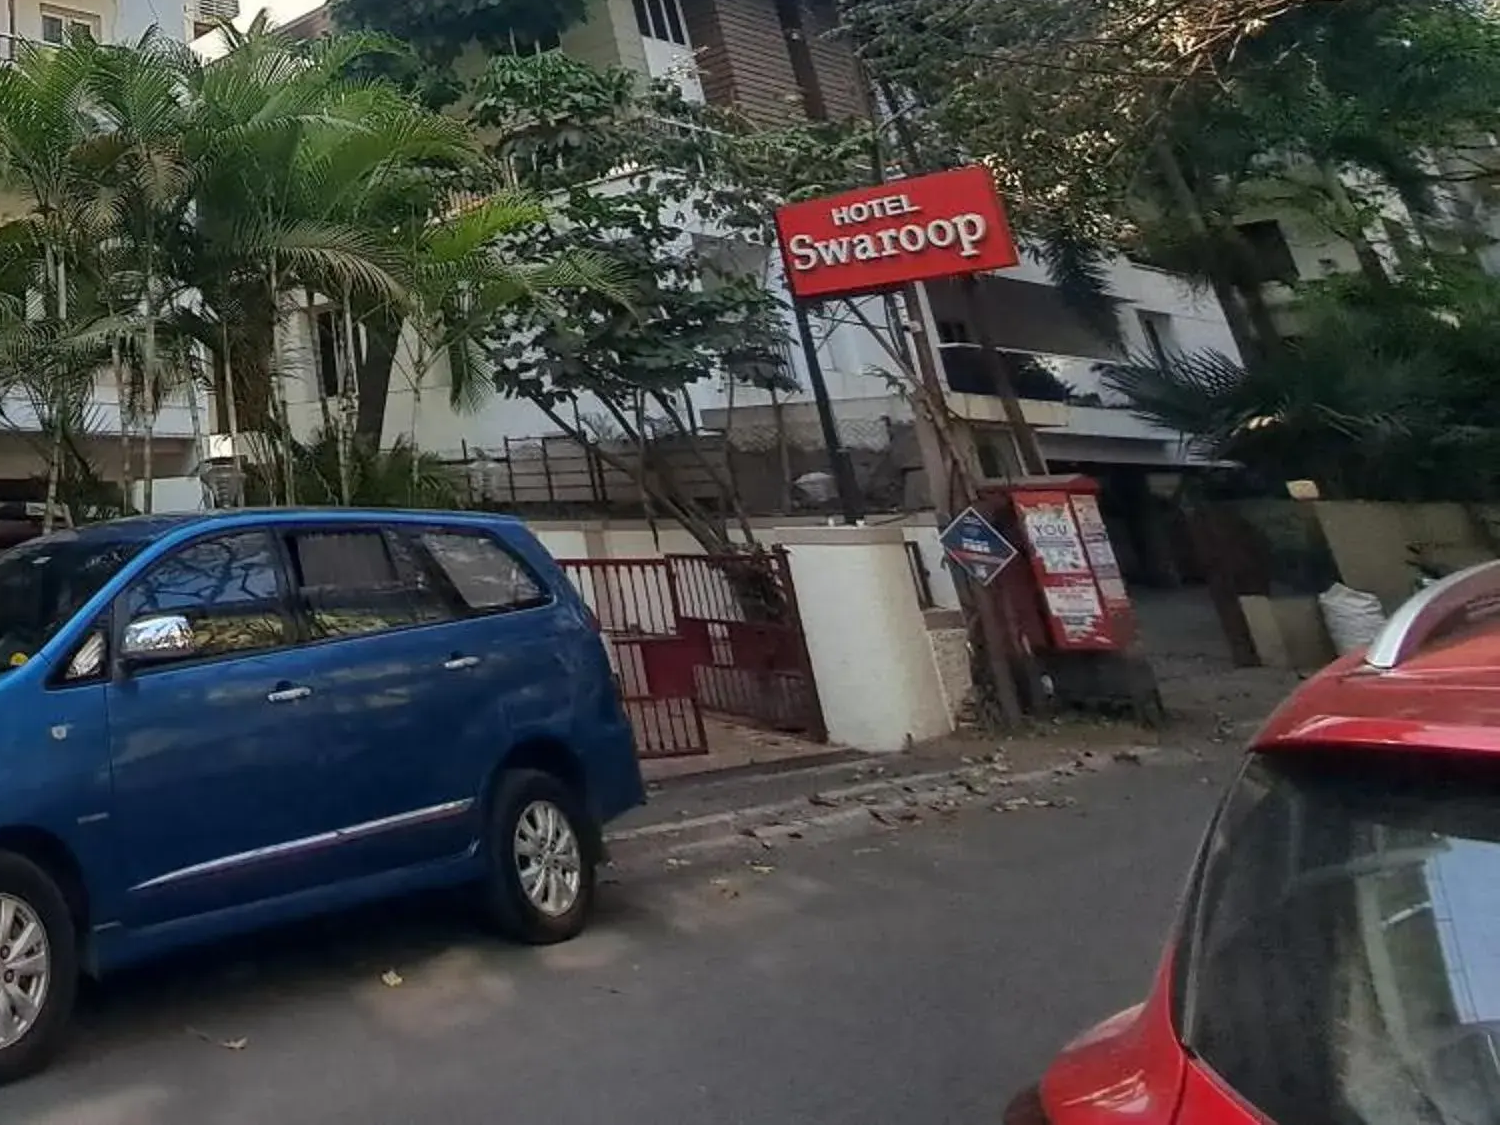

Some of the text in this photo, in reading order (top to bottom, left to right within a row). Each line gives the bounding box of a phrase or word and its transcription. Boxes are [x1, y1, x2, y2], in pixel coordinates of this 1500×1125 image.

[831, 194, 921, 226] HOTEL
[789, 212, 987, 271] Swaroop
[1034, 524, 1068, 536] YOU
